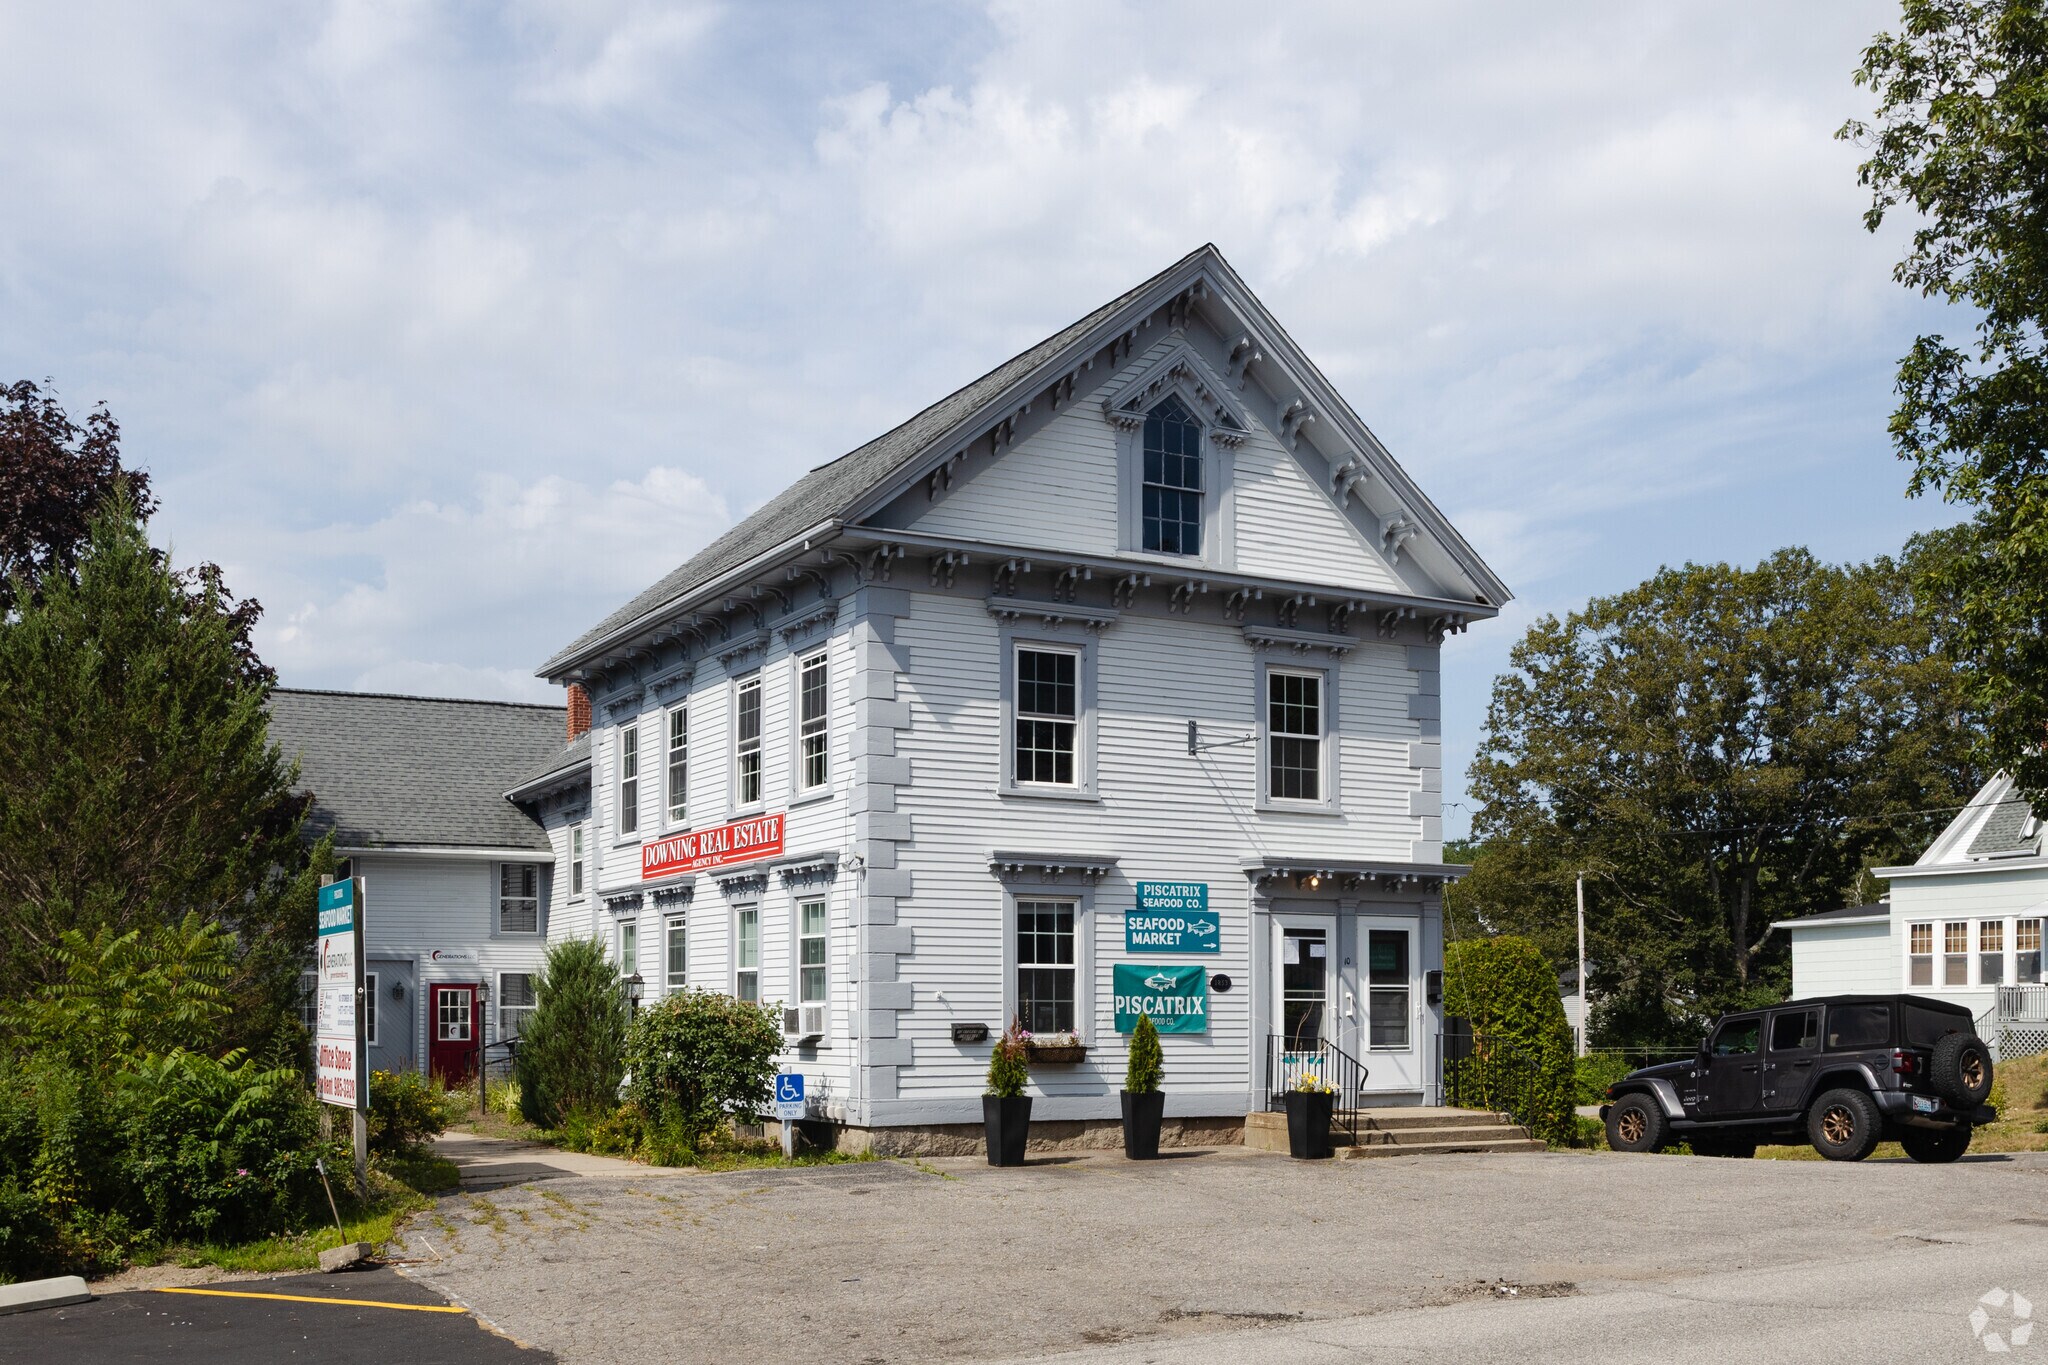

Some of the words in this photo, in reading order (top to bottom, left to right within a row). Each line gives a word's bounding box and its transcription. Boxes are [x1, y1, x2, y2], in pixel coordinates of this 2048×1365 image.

[645, 836, 696, 867] DOWNING
[699, 829, 730, 856] REAL
[733, 818, 779, 849] ESTATE
[692, 856, 711, 868] AGENCY
[712, 855, 724, 865] INC.
[1143, 884, 1201, 897] PISCATRIX
[1143, 898, 1183, 908] SEAFOOD
[1186, 898, 1202, 909] CO.
[319, 908, 336, 929] SEAFOOD
[336, 905, 352, 926] MARKET
[1128, 917, 1185, 931] SEAFOOD
[1132, 932, 1182, 945] MARKET
[1344, 957, 1351, 966] 10
[1115, 995, 1204, 1015] PISCATRIX
[320, 1044, 334, 1068] Office
[335, 1045, 352, 1072] Space
[324, 1075, 333, 1095] Rent
